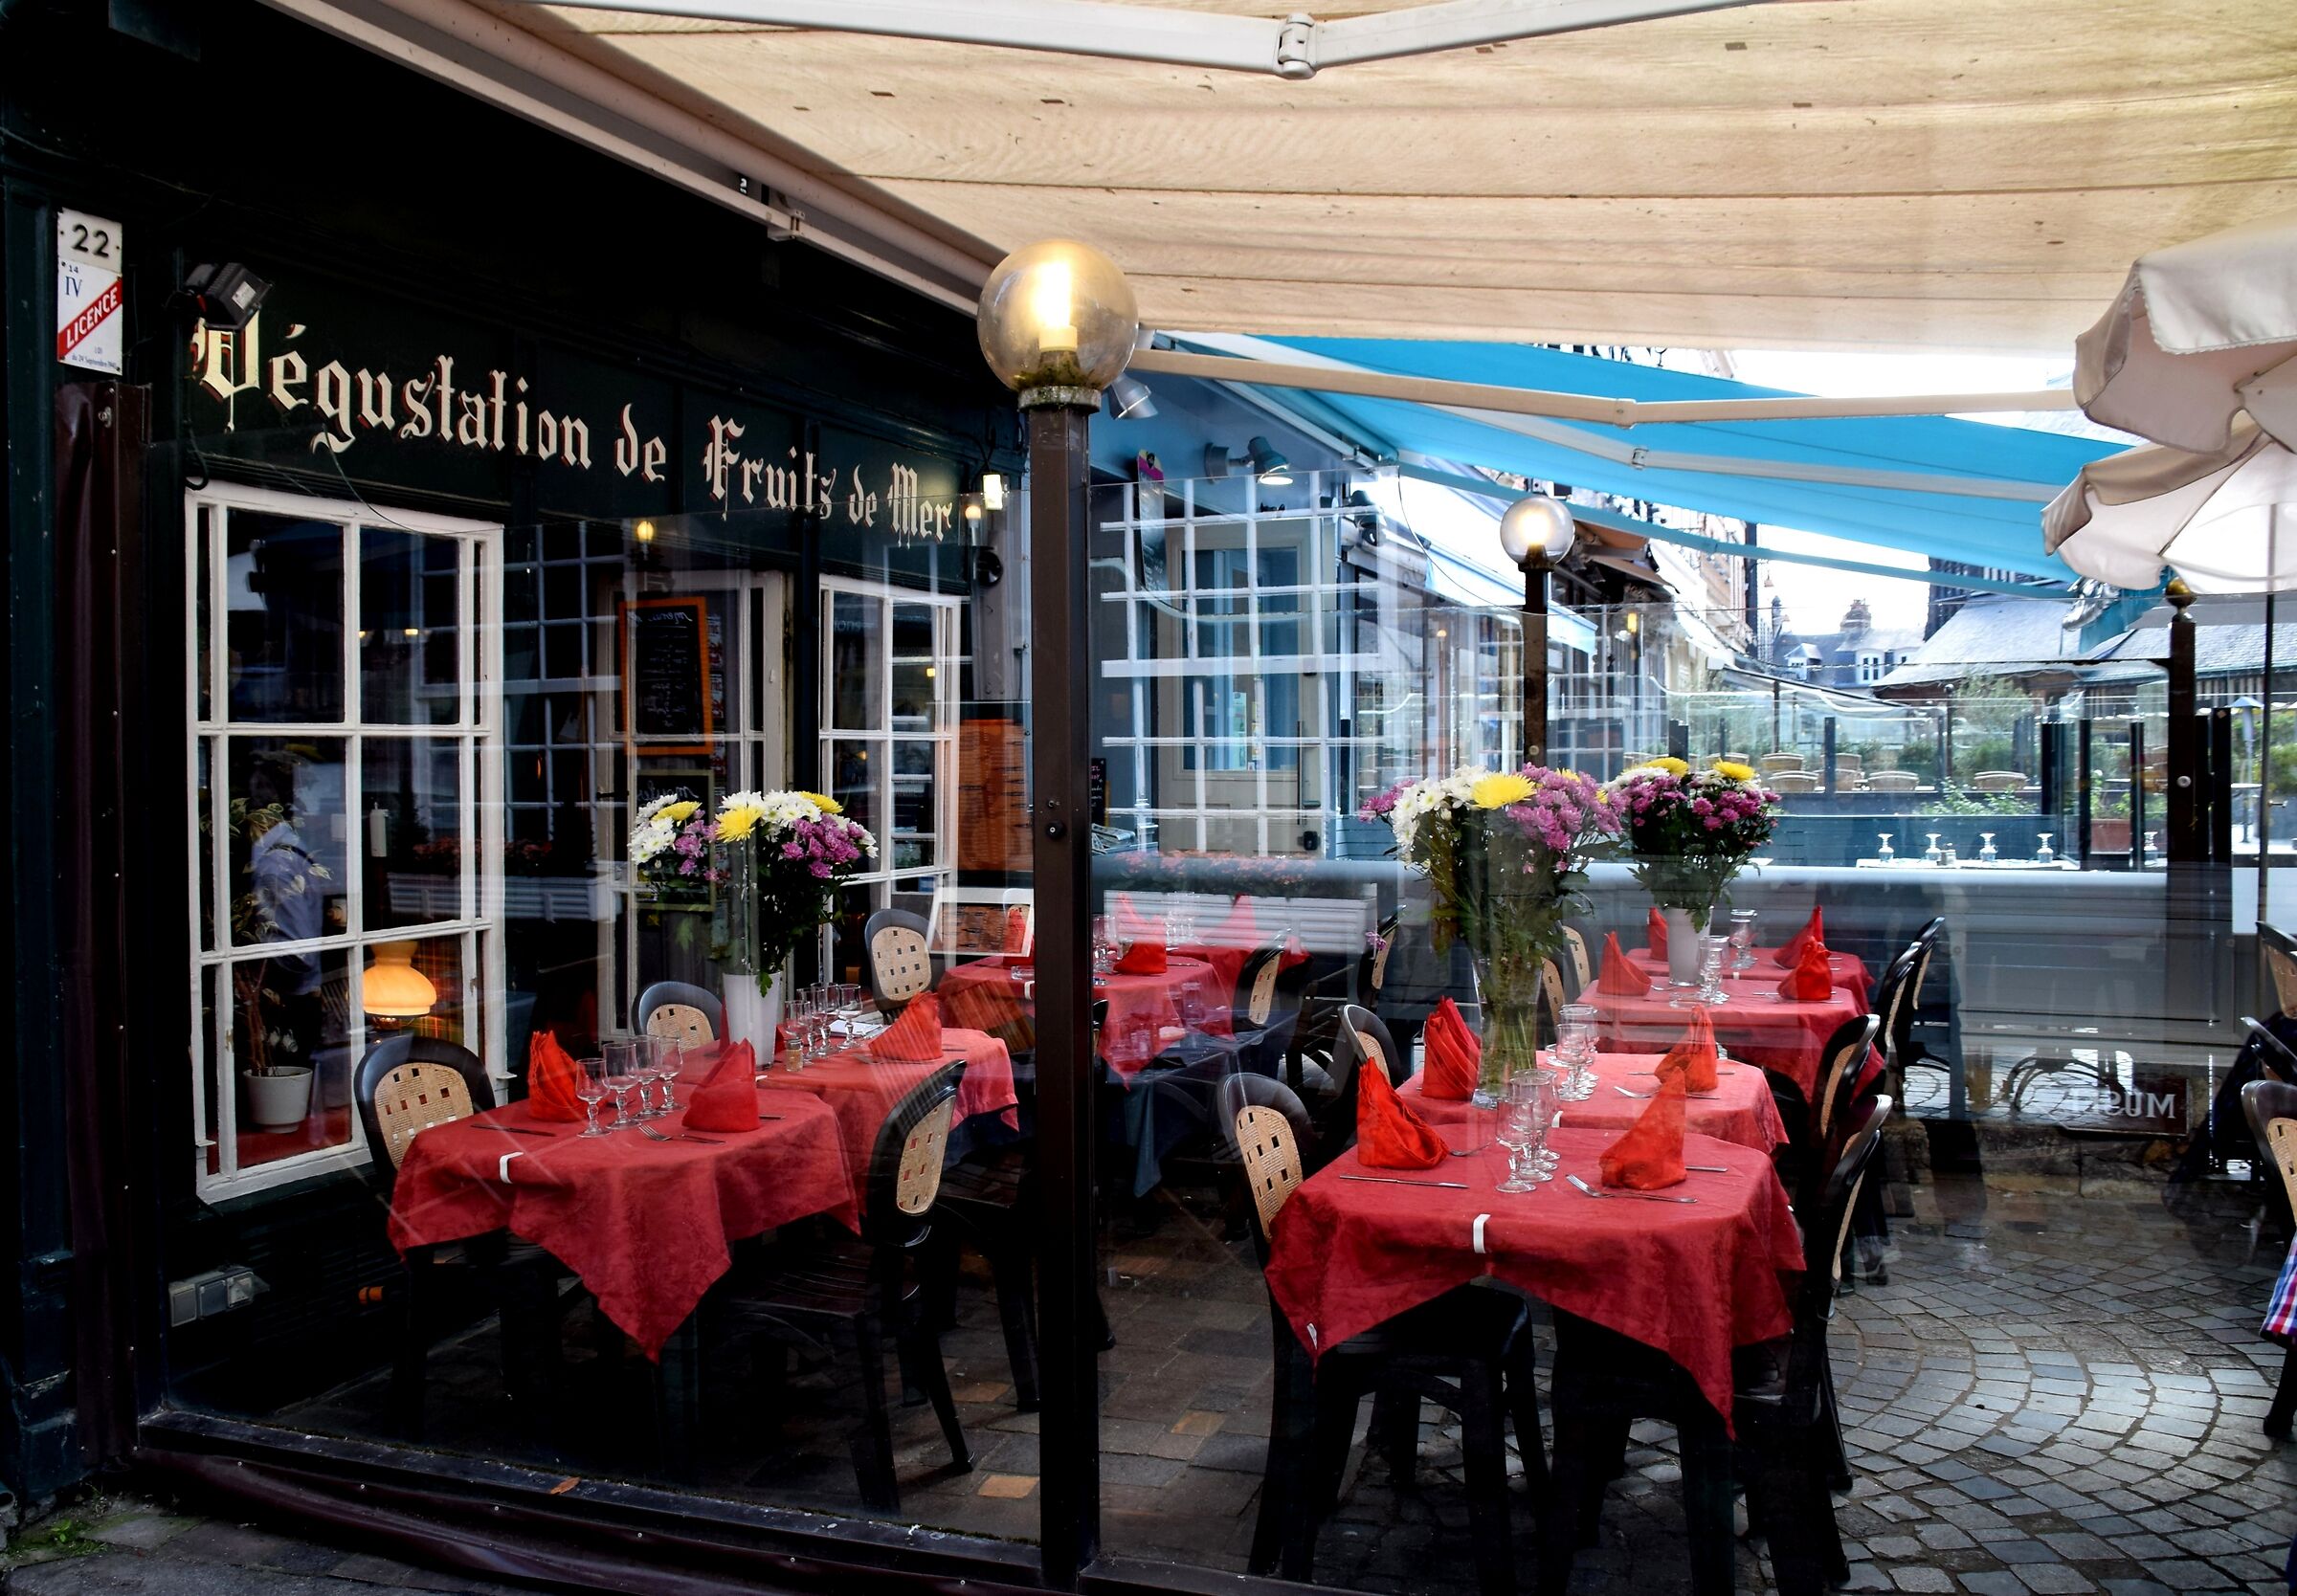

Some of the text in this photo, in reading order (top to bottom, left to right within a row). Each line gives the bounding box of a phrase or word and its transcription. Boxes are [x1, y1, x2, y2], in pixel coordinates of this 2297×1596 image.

[72, 223, 110, 258] 22
[65, 276, 83, 298] IV
[69, 265, 79, 274] 14
[65, 286, 119, 350] LICENCE
[190, 311, 953, 549] Dégustation de Fruits de Mer
